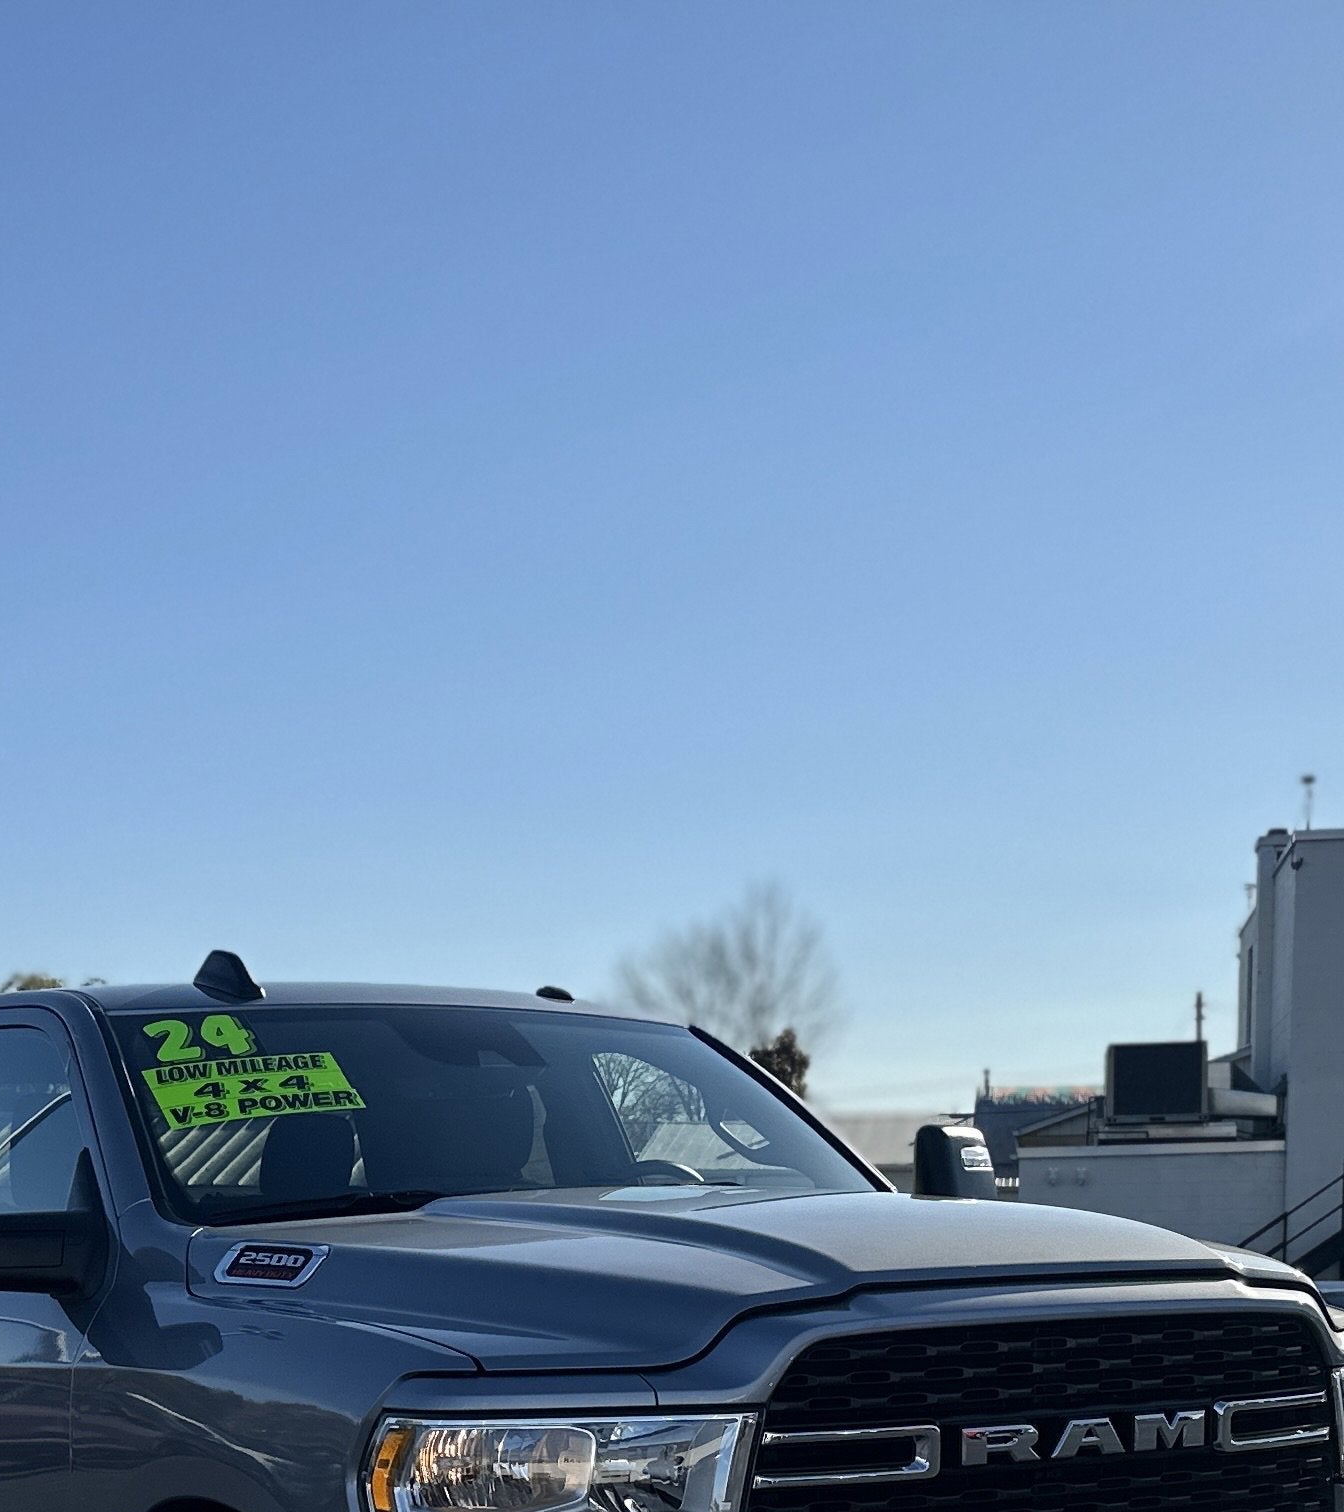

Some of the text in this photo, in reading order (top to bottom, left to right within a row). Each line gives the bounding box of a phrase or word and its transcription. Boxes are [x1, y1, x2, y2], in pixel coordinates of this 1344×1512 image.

[143, 1015, 256, 1063] 24
[156, 1054, 326, 1084] LOW MILEAGE
[170, 1090, 358, 1125] V-8 POWER
[239, 1252, 305, 1267] 2500
[961, 1409, 1206, 1467] RAM
